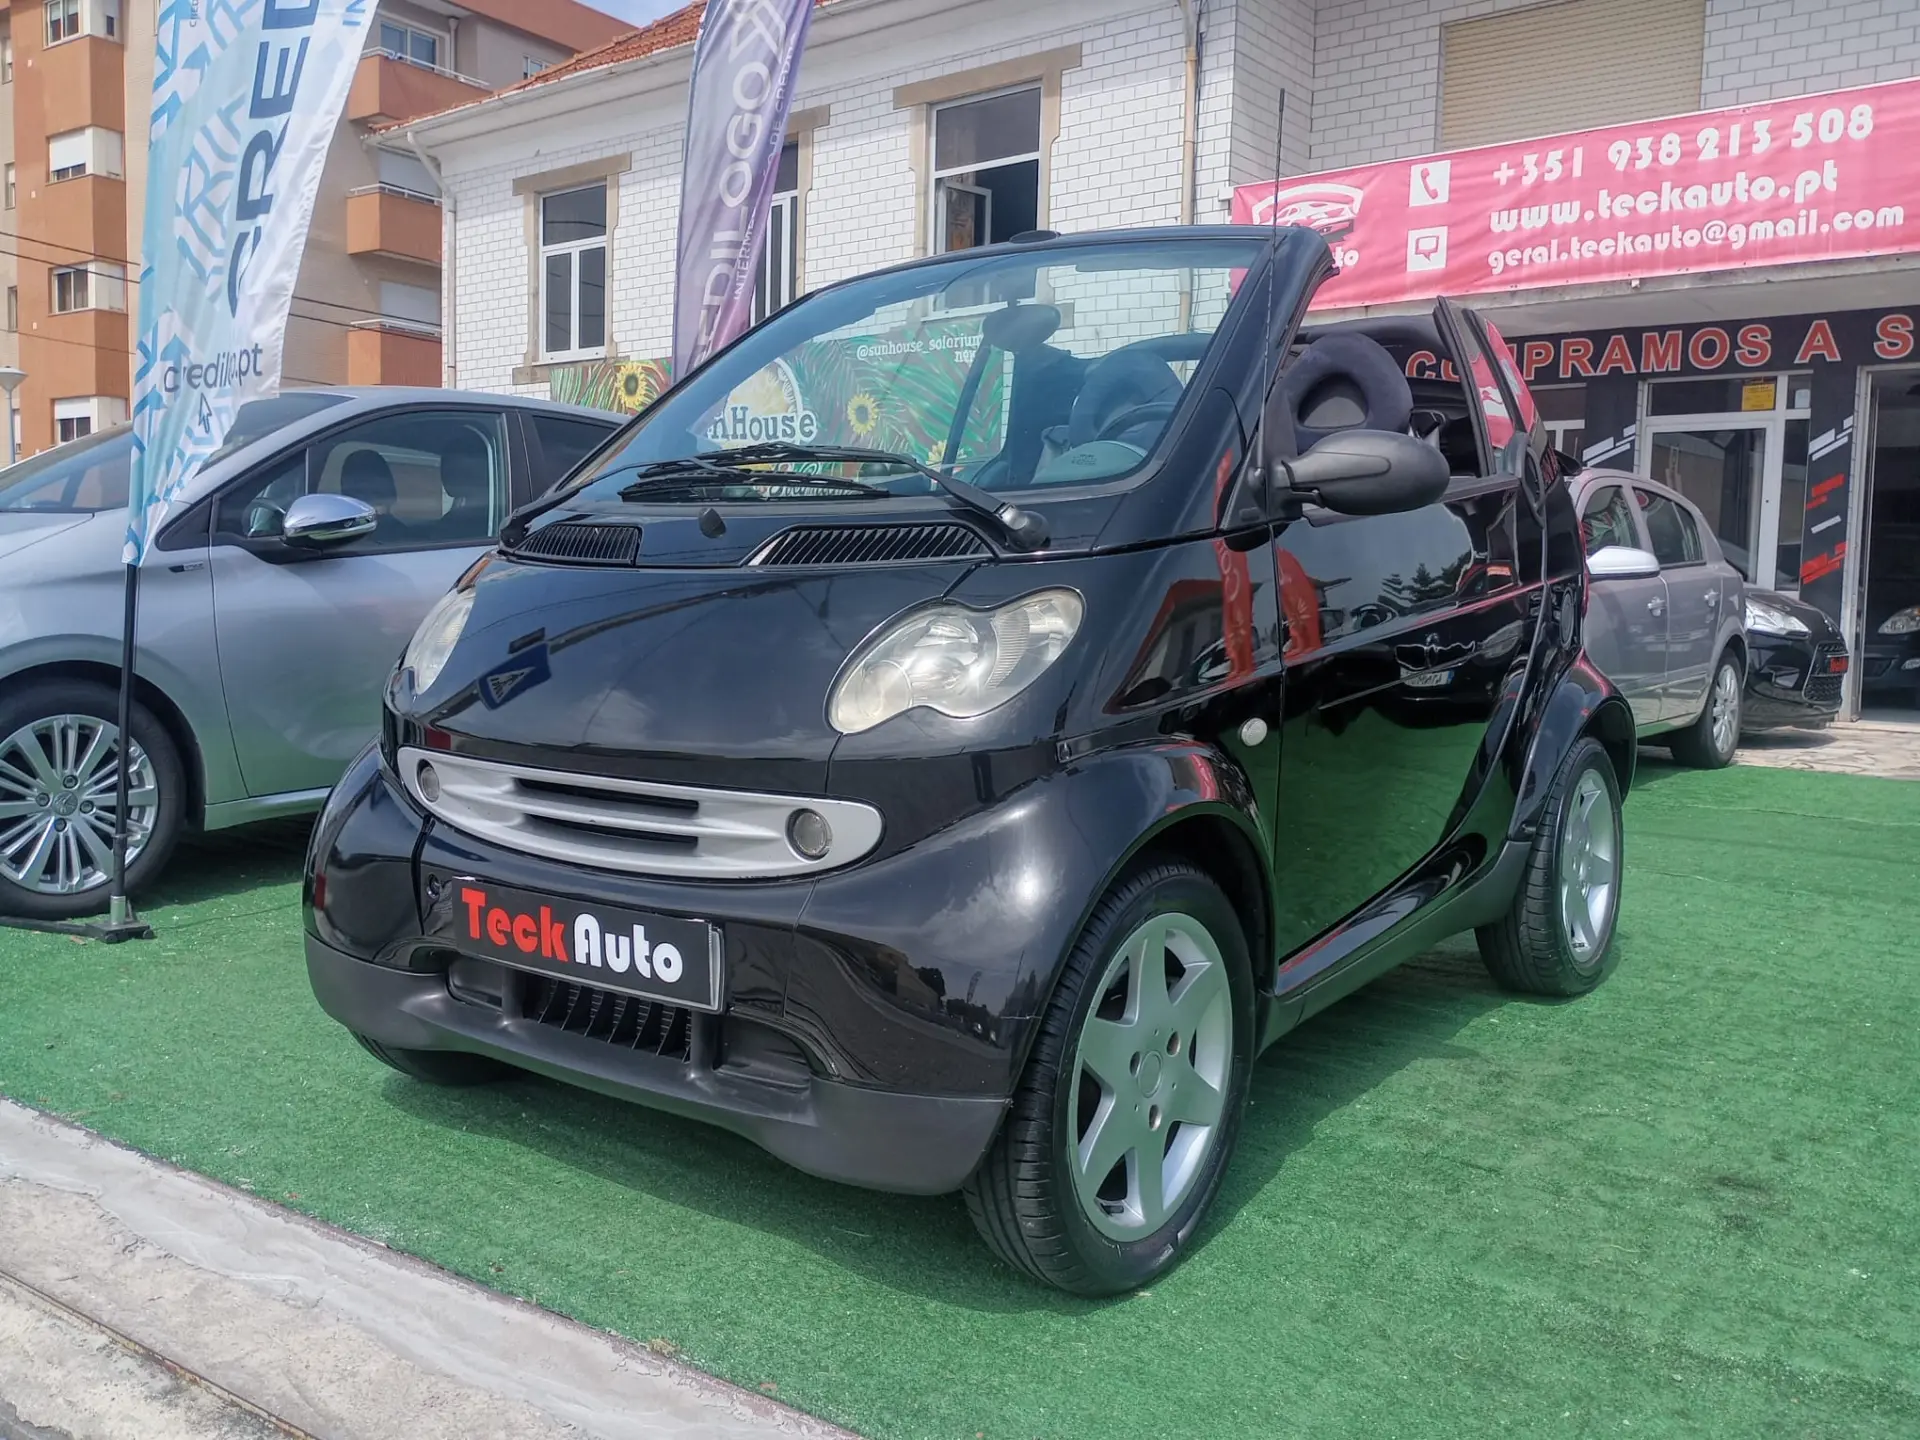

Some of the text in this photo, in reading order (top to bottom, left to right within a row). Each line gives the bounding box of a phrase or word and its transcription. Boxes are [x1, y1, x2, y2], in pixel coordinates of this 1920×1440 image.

[1492, 104, 1873, 186] +351 938 213 508
[1490, 160, 1838, 232] www.teckauto.pt
[1487, 206, 1905, 275] geral.teckauto@gmail.com
[1405, 324, 1773, 382] CPRAMOS
[1794, 320, 1840, 363] A
[461, 887, 683, 984] Teck Auto
